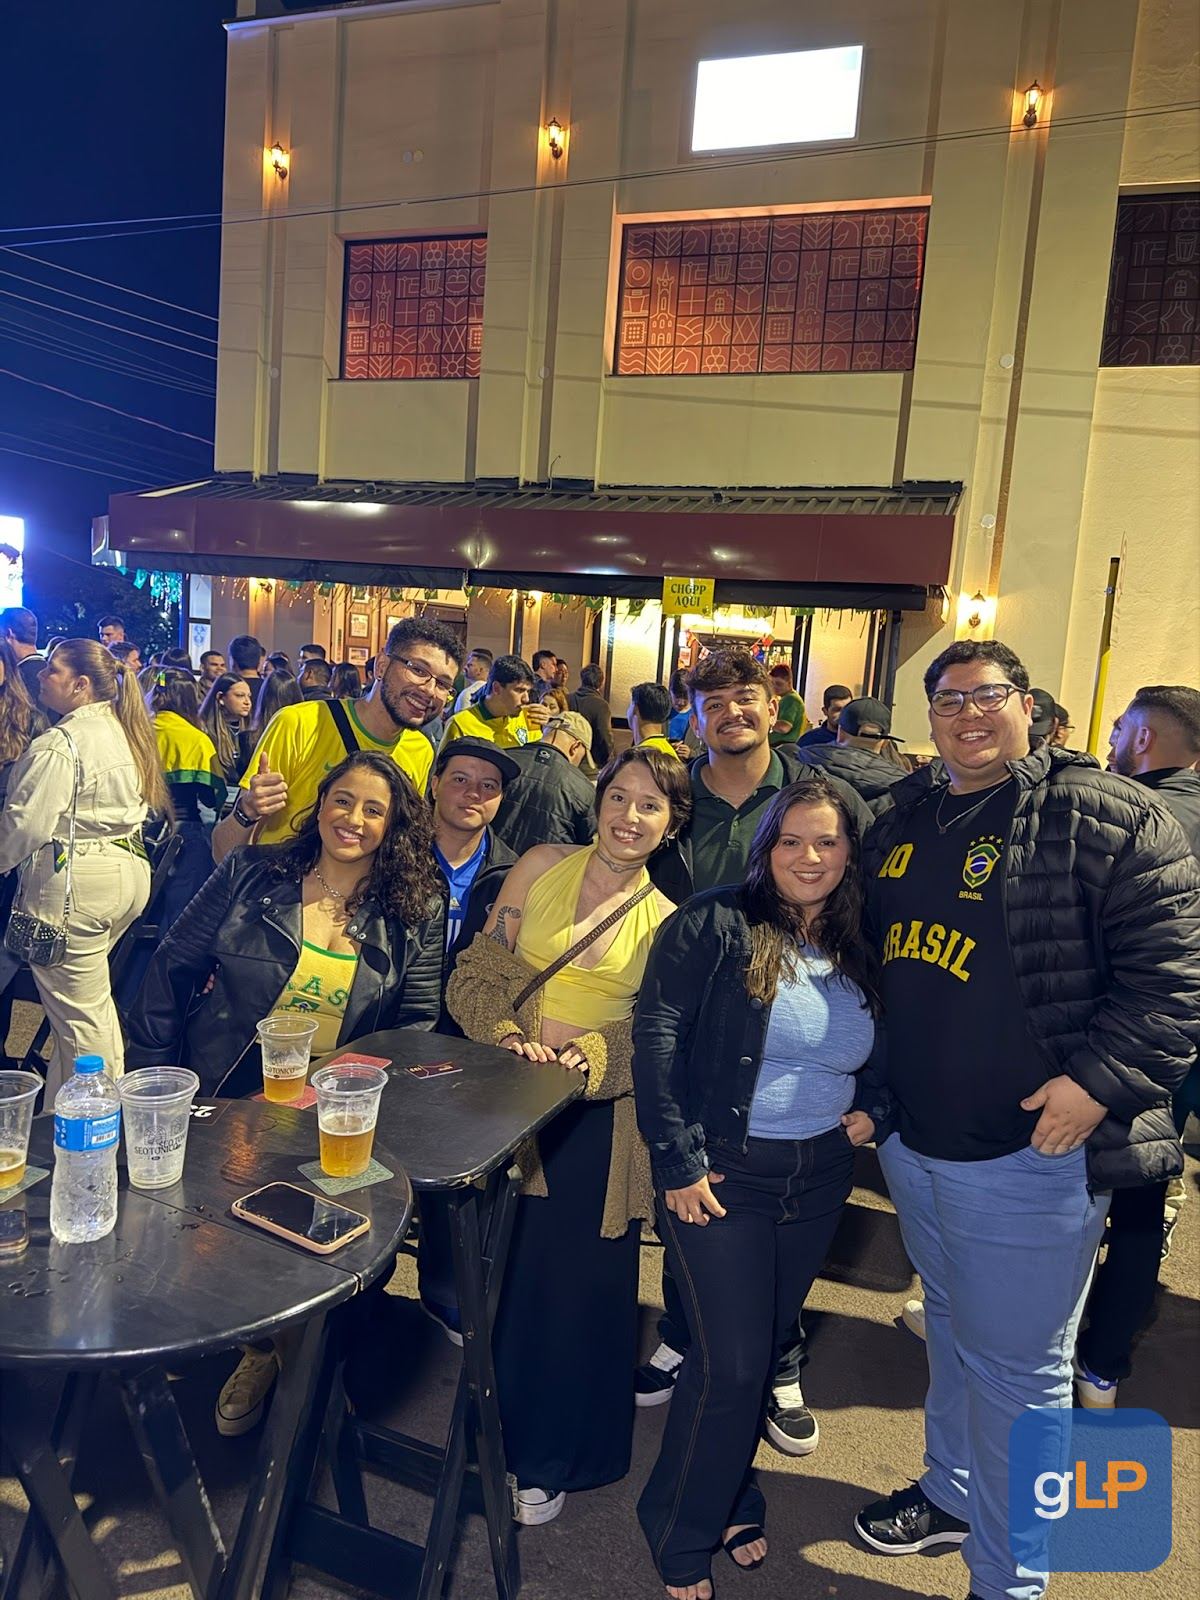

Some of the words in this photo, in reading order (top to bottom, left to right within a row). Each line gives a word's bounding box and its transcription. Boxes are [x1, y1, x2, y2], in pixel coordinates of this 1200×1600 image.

[670, 583, 707, 595] CHOPP
[674, 595, 701, 608] AQUI
[878, 843, 914, 878] 10
[958, 890, 983, 901] BRASIL
